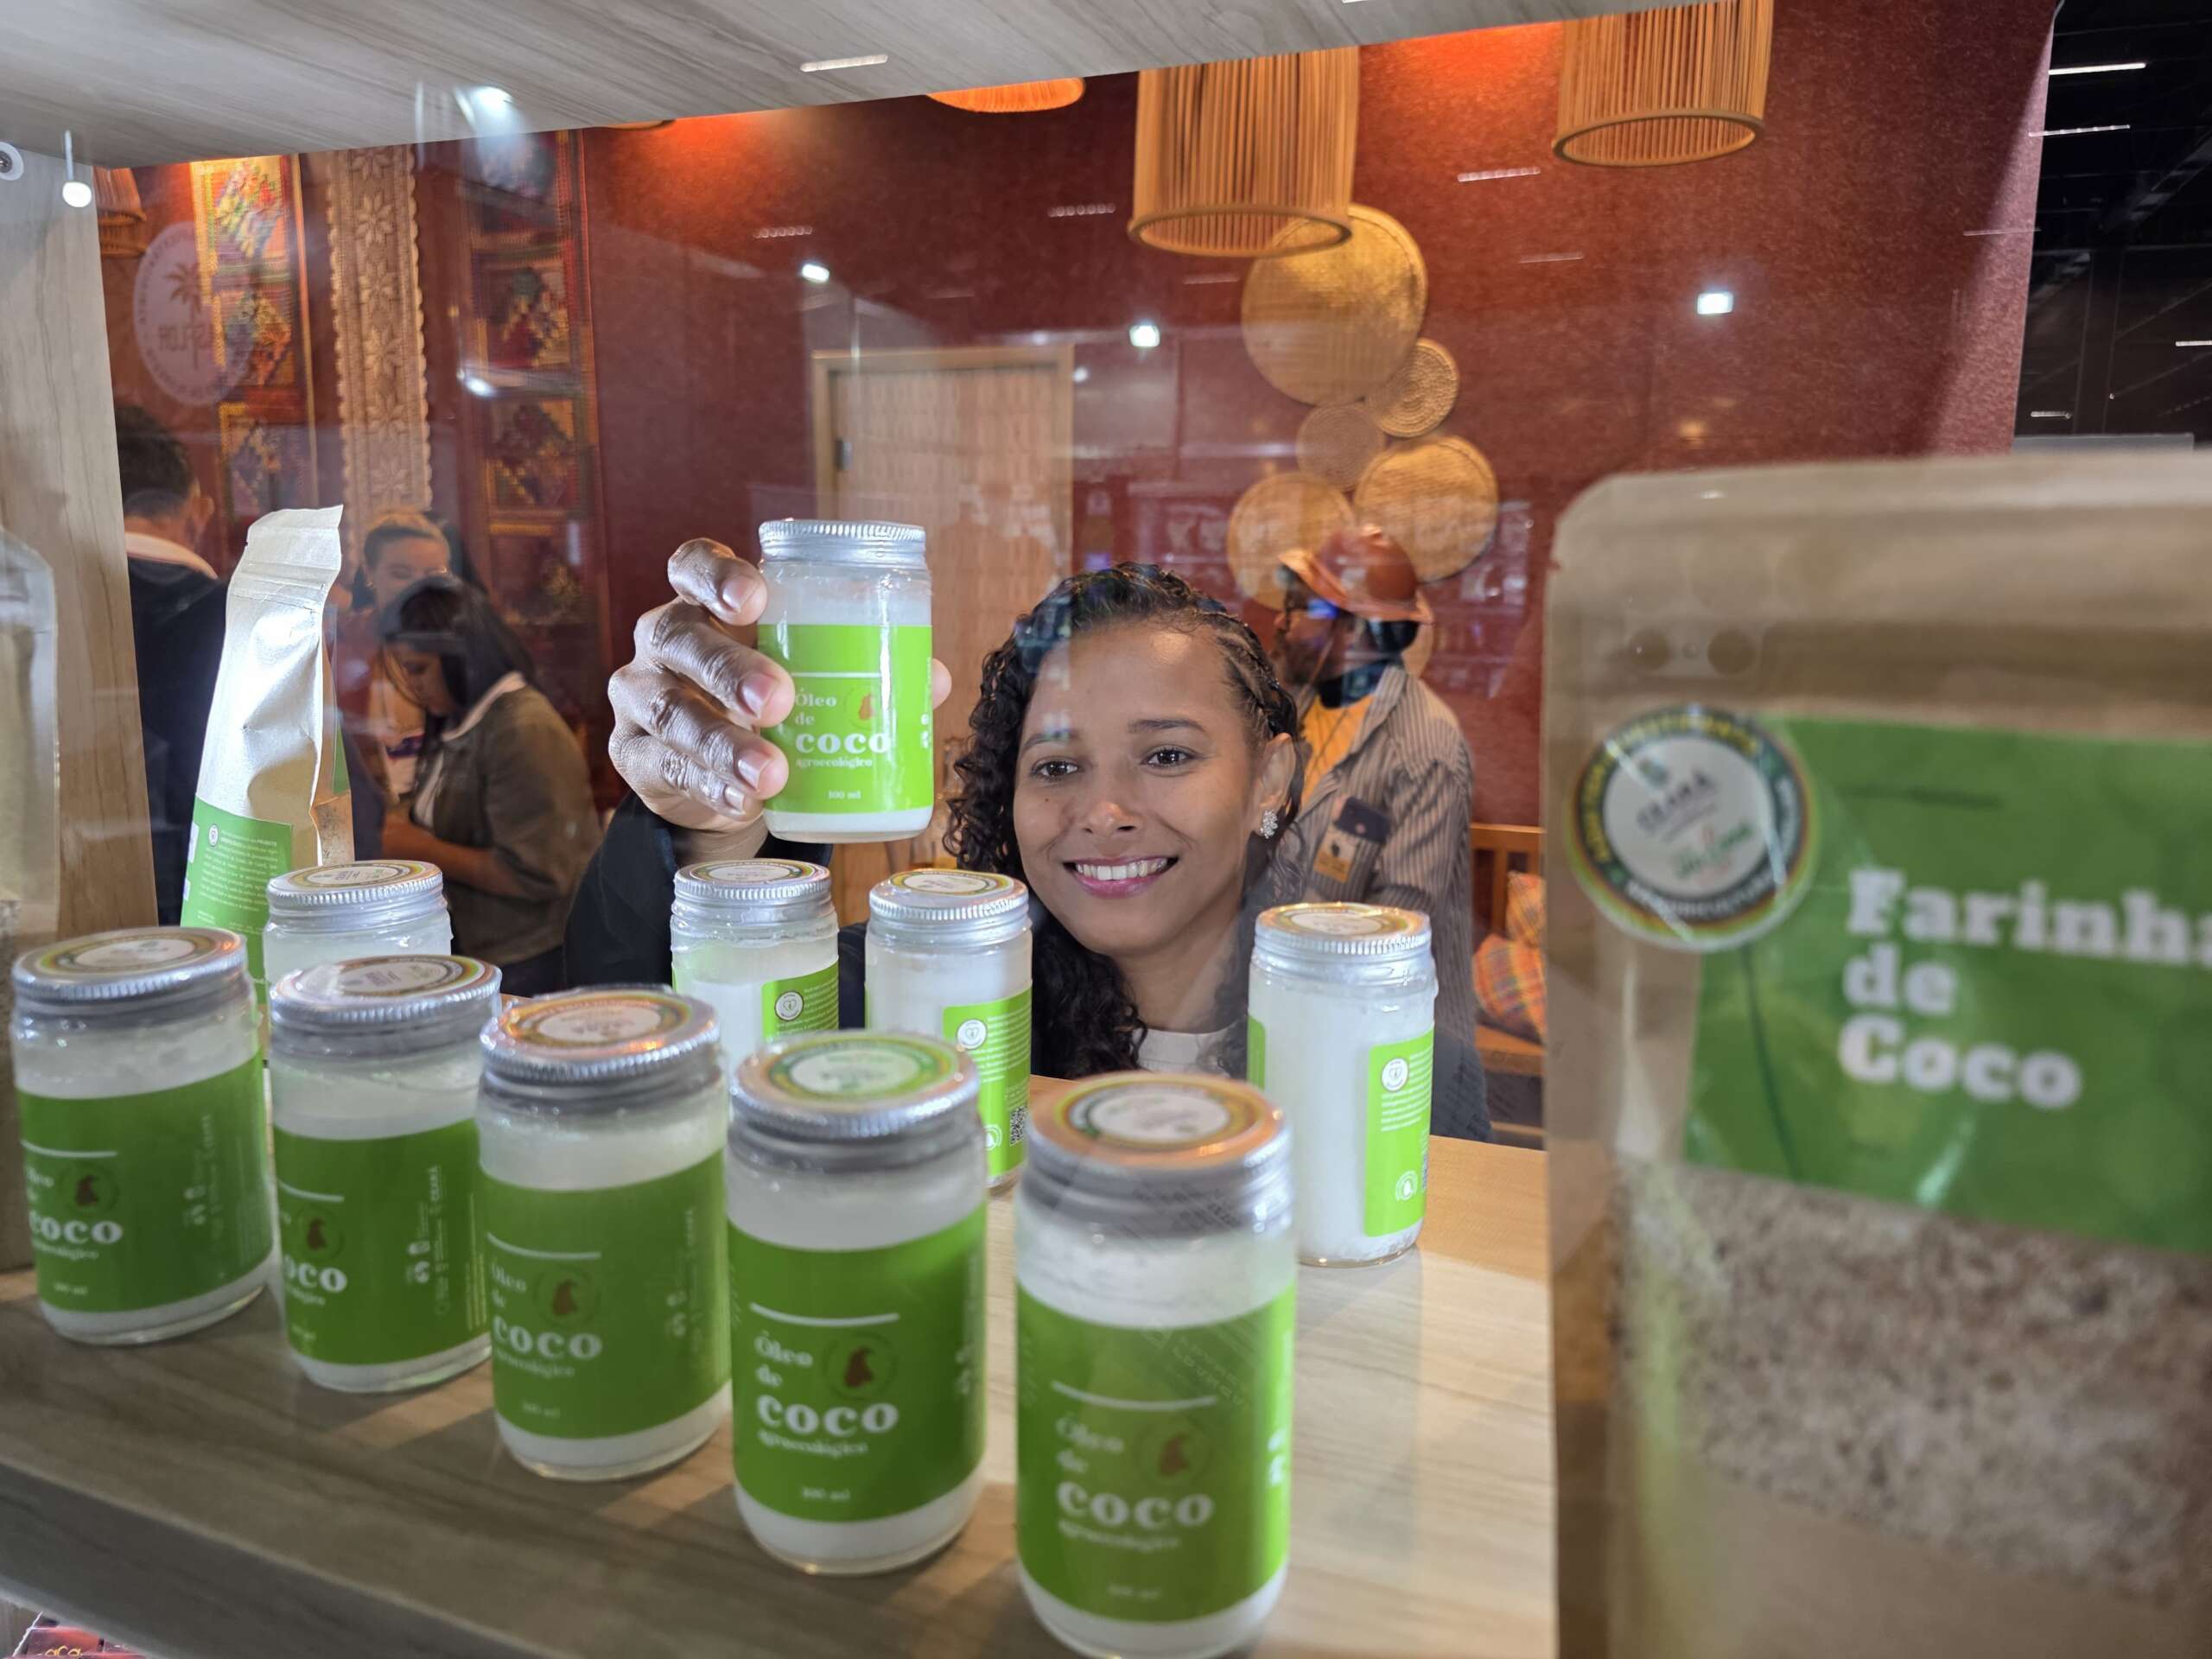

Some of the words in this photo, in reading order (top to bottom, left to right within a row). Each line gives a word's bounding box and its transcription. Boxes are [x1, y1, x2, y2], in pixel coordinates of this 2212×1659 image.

[795, 688, 837, 707] Óleo
[795, 713, 815, 726] de
[796, 733, 891, 754] coco
[1842, 943, 1959, 1017] de
[1837, 1013, 2082, 1110] Coco
[493, 1315, 603, 1360] coco
[757, 1395, 899, 1438] coco
[1056, 1481, 1215, 1531] coco
